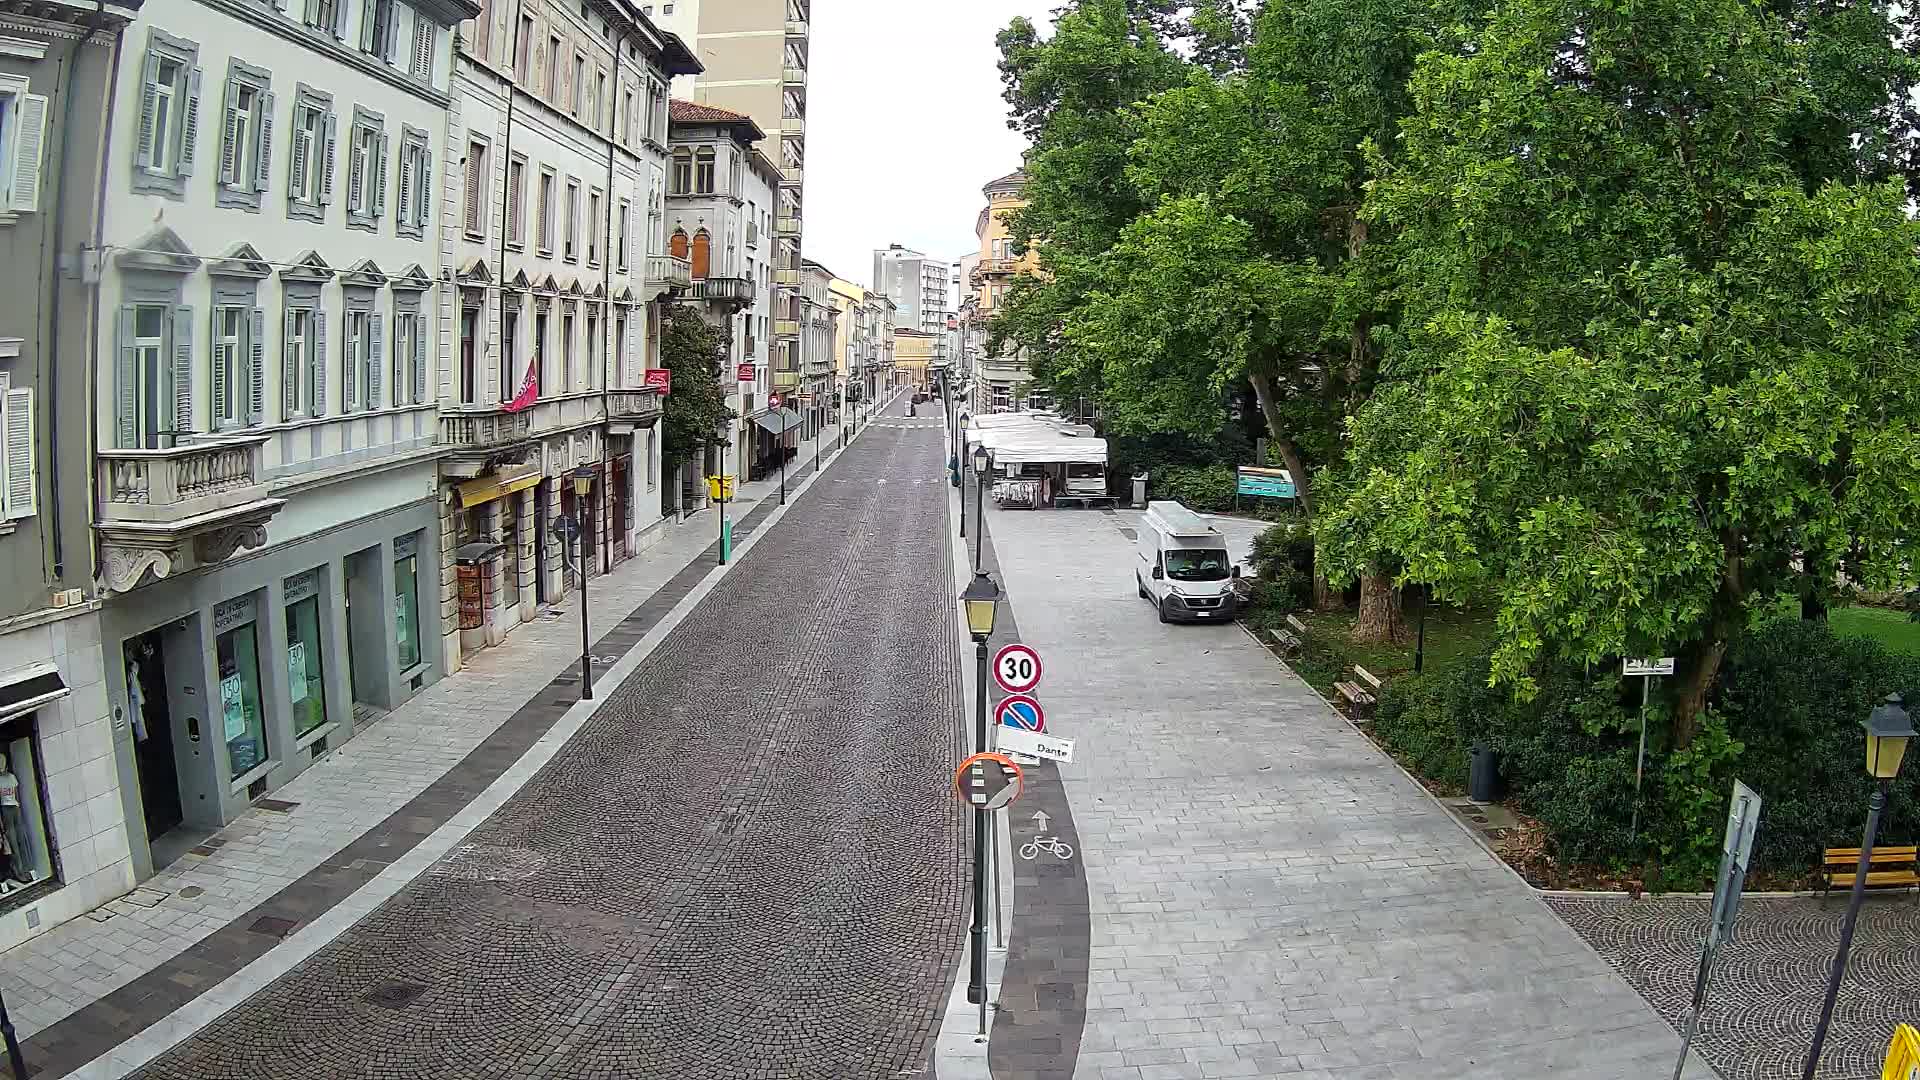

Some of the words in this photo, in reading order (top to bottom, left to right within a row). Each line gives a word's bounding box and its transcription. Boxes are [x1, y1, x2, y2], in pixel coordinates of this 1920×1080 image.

[1005, 657, 1031, 679] 30
[222, 677, 240, 699] 130
[1037, 743, 1067, 756] Dante
